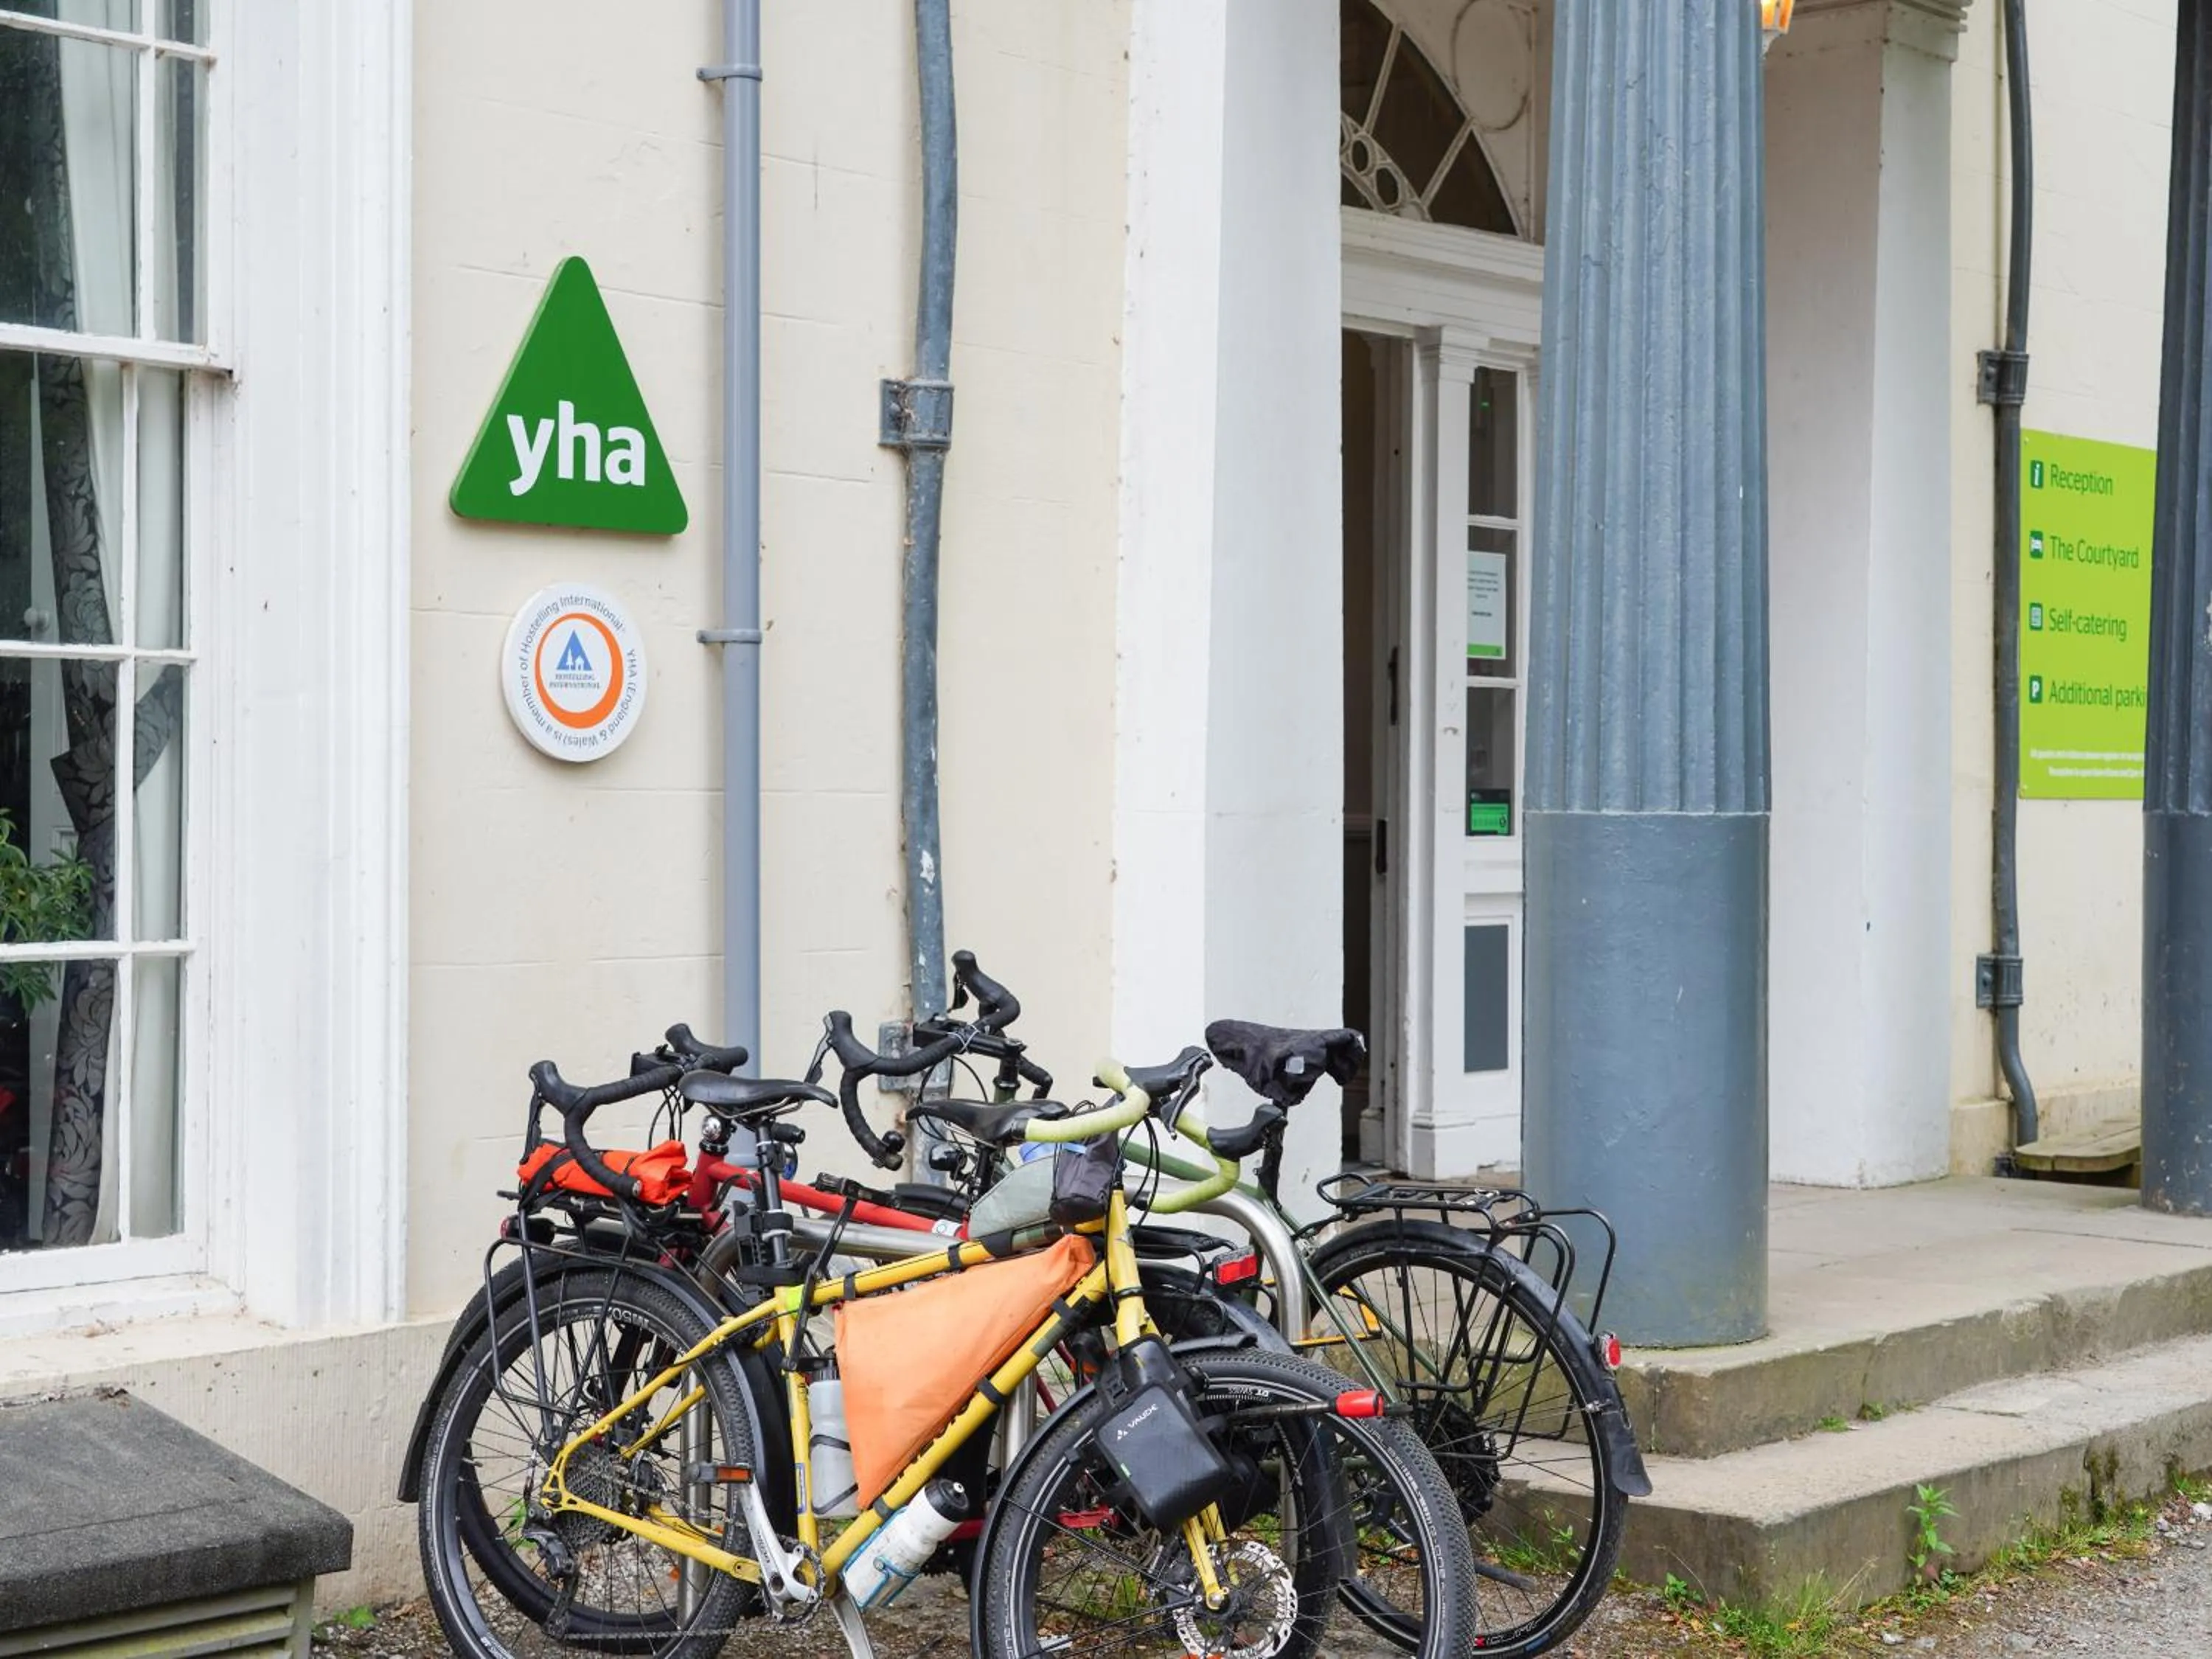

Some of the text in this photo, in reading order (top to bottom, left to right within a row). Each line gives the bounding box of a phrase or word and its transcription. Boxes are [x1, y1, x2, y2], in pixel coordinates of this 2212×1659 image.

[507, 399, 646, 496] yha
[2050, 464, 2113, 496] Reception
[2050, 535, 2139, 572] The Courtyard
[521, 602, 559, 654] Hostelling
[560, 594, 623, 631] International
[2049, 608, 2127, 642] Self-catering
[520, 655, 530, 671] of
[627, 649, 638, 678] YHA
[520, 675, 545, 727] member
[610, 682, 636, 735] (England
[2049, 680, 2146, 711] Additional parki
[554, 731, 563, 743] is
[563, 734, 599, 748] Wales)
[599, 729, 608, 740] &
[1127, 1403, 1159, 1429] VAUDE
